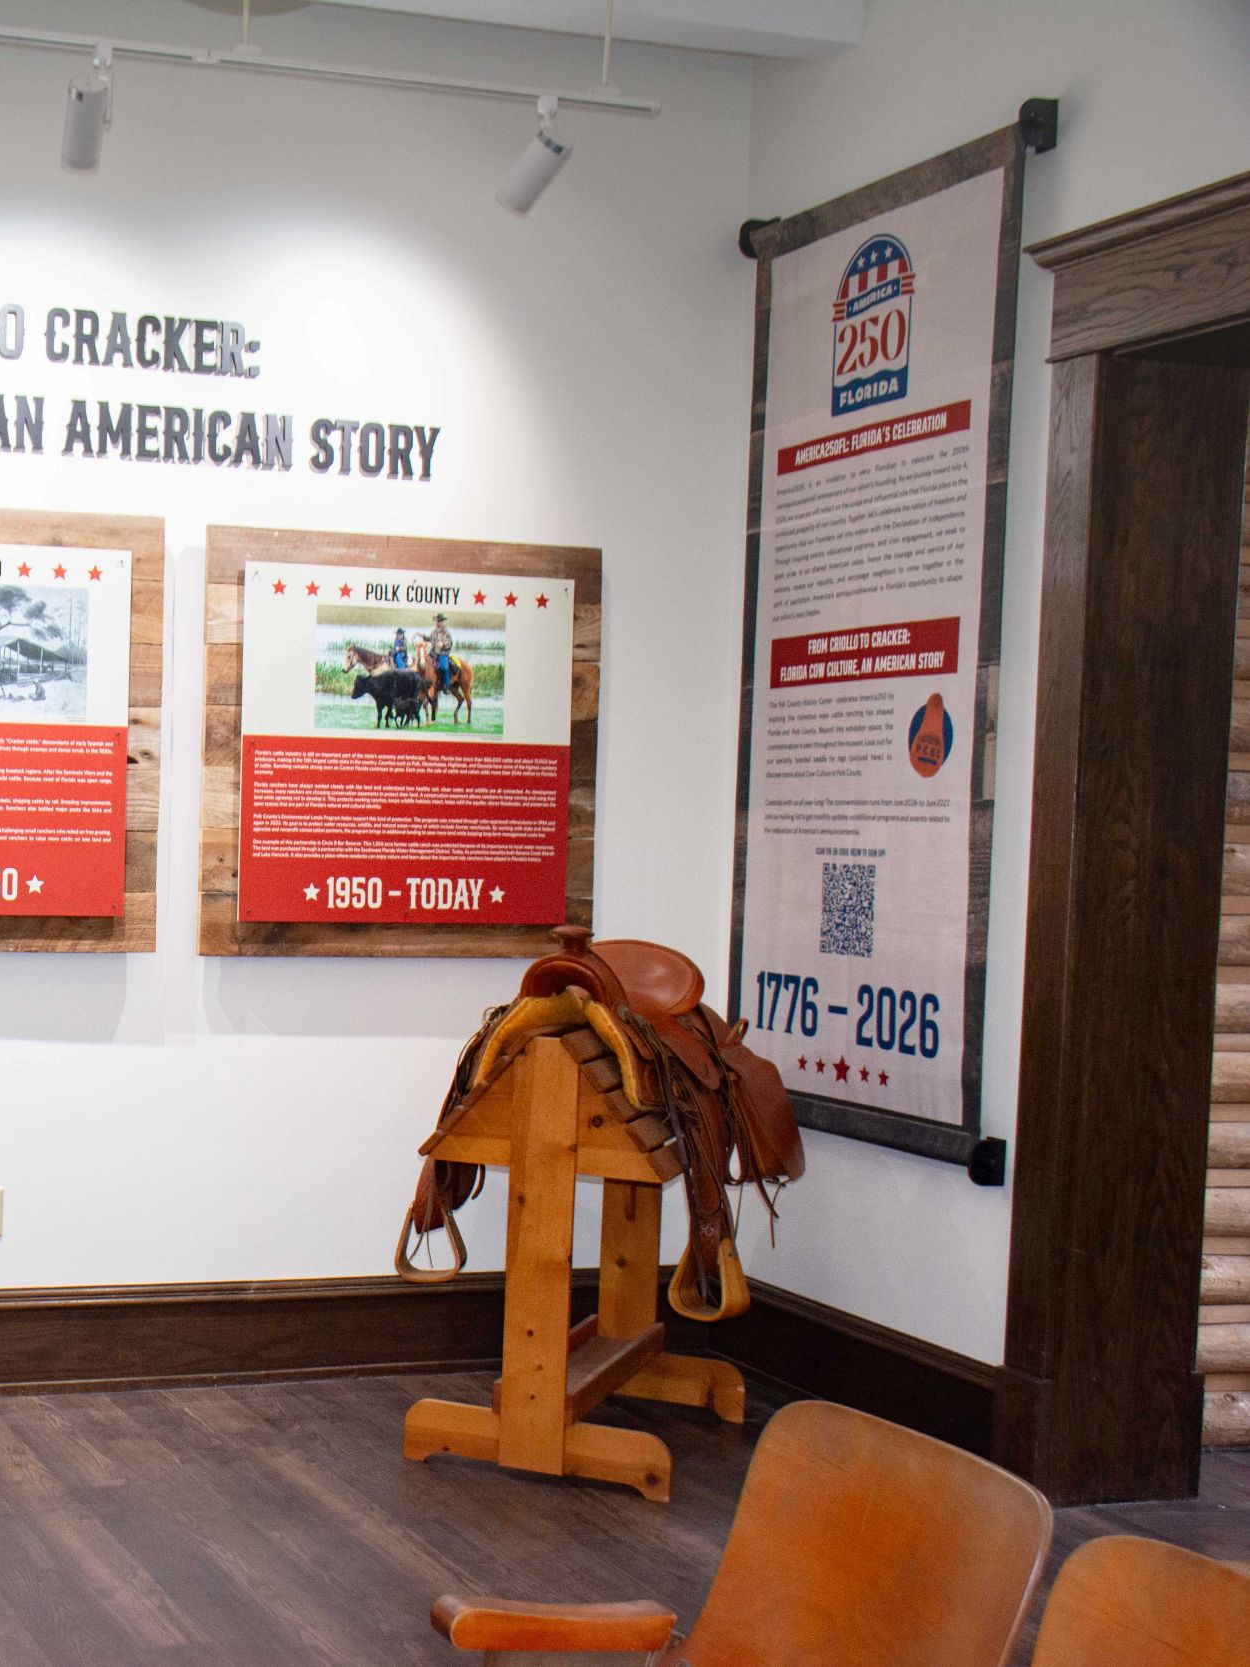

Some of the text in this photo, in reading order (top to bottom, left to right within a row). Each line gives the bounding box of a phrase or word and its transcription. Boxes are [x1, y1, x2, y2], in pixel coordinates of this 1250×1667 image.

[853, 282, 893, 314] AMERICA
[44, 307, 260, 379] CRACKER:
[836, 308, 906, 376] 250
[839, 377, 898, 408] FLORIDA
[61, 399, 294, 472] AMERICAN
[308, 418, 441, 483] STORY
[794, 411, 947, 467] AMERICA250FL: FLORIDA'S CELEBRATION
[365, 582, 460, 606] POLK COUNTY
[808, 627, 910, 656] FROM CRIOLLO TO CRACKER:
[780, 650, 945, 682] FLORIDA COW CULTURE, AN AMERICAN STORY
[326, 876, 383, 909] 1950
[406, 877, 485, 910] TODAY
[756, 970, 819, 1037] 1776
[856, 983, 940, 1059] 2026
